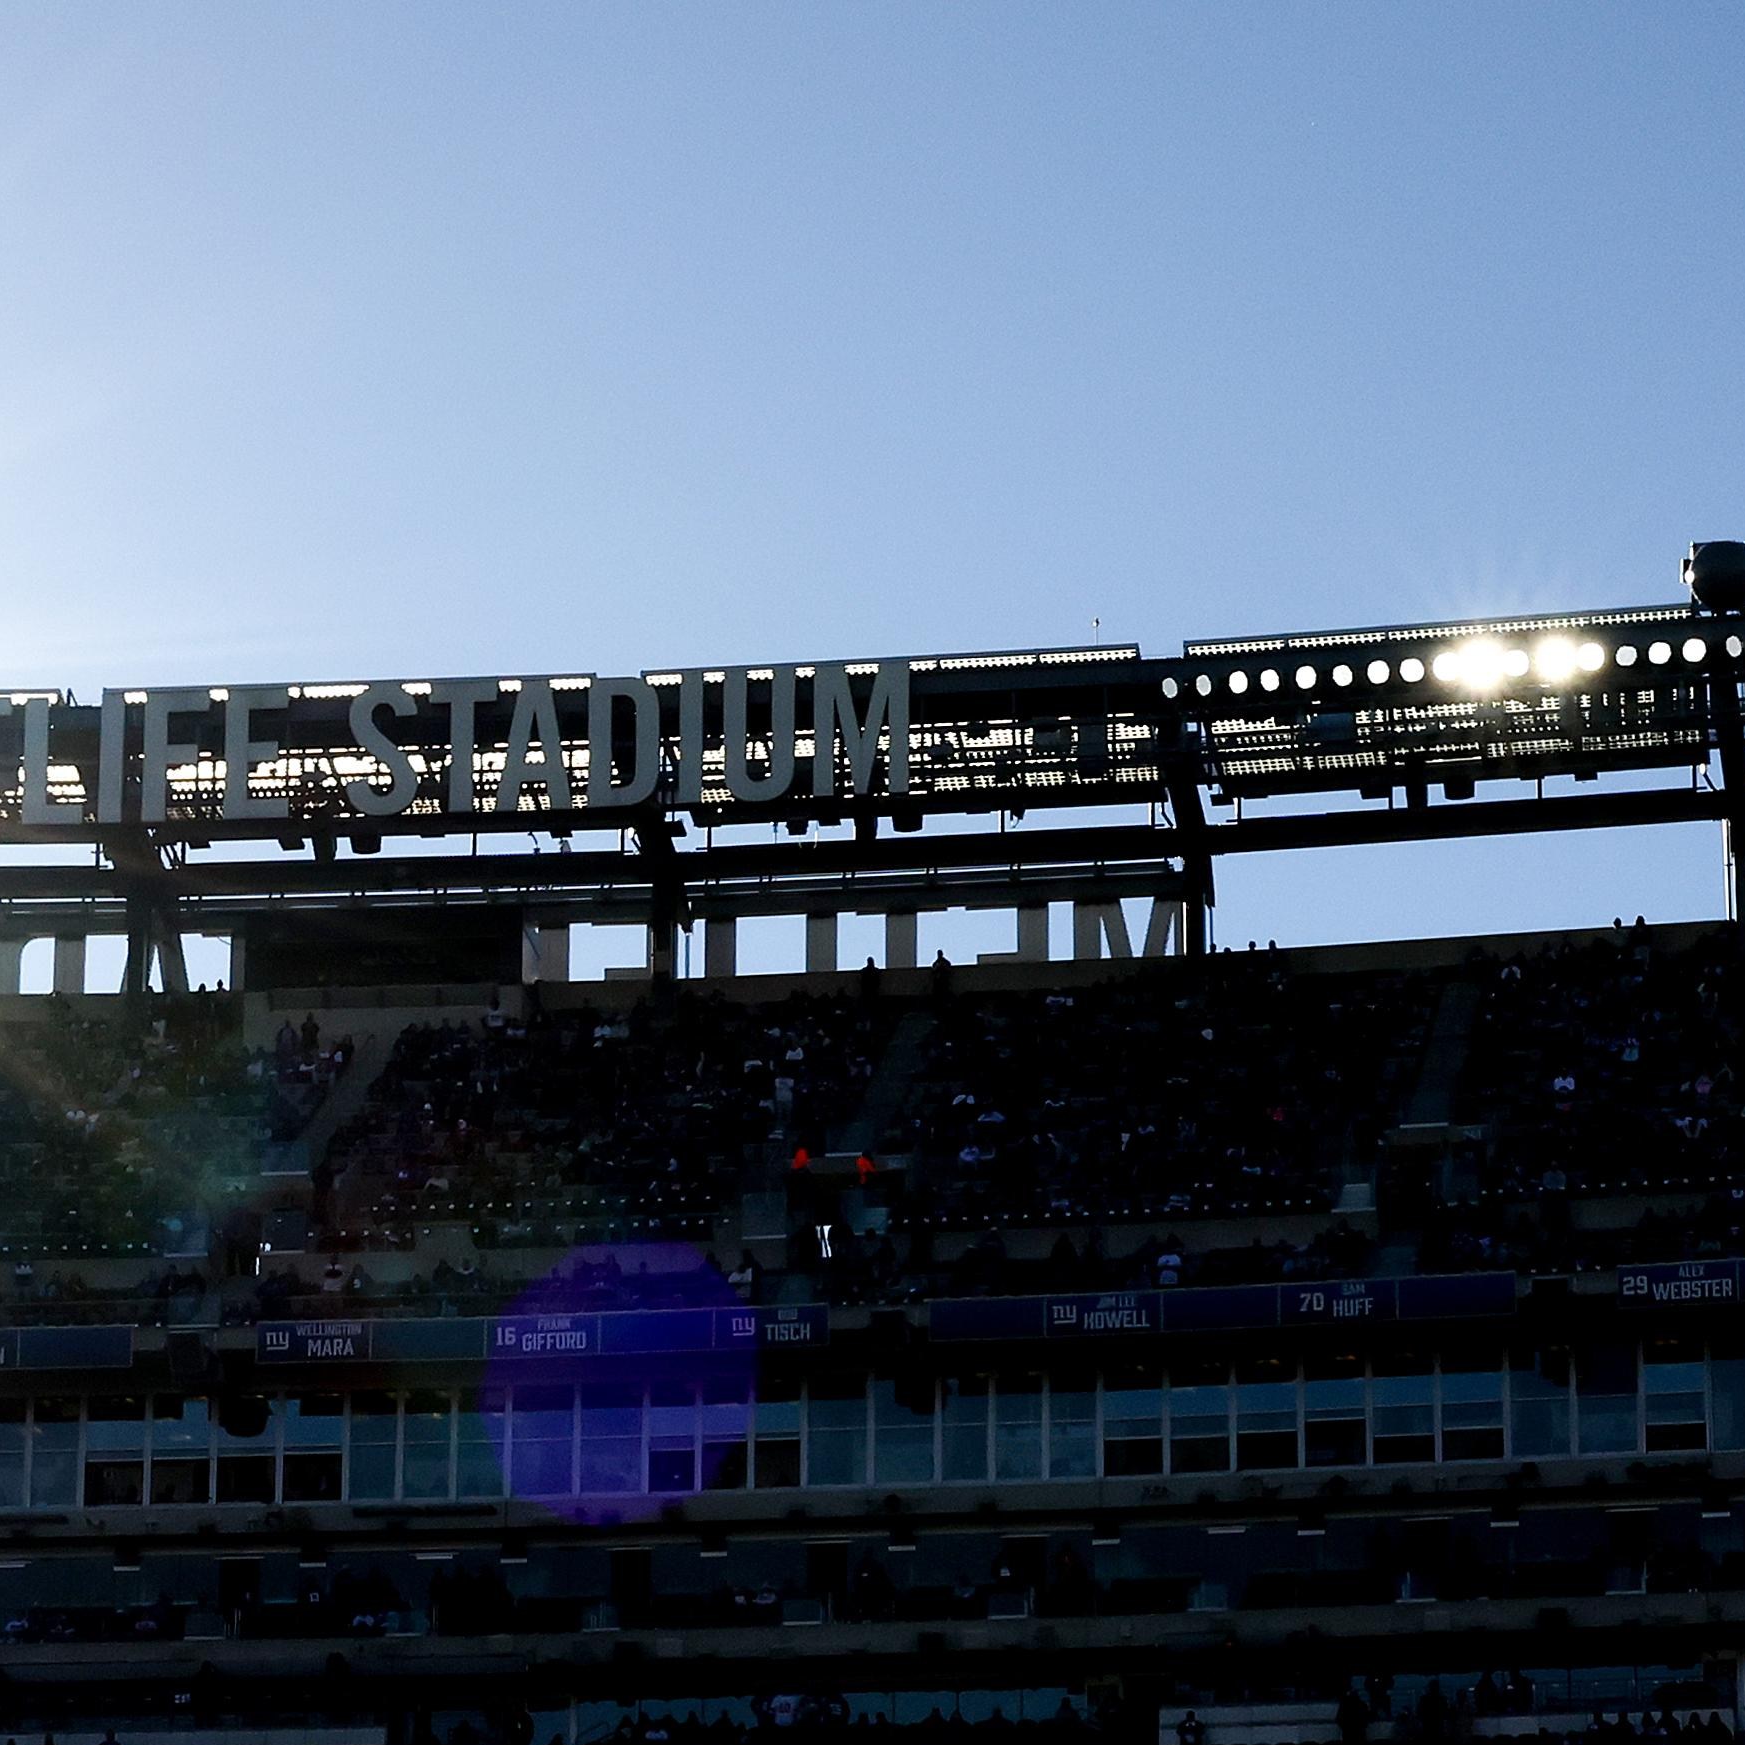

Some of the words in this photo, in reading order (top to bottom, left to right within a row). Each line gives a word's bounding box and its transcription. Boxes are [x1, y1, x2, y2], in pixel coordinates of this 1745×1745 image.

[344, 659, 910, 818] STADIUM
[1622, 1275, 1648, 1296] 29
[1653, 1279, 1733, 1301] WEBSTER
[1299, 1292, 1325, 1313] 70
[1332, 1298, 1375, 1318] HUFF
[1083, 1308, 1150, 1330] HOWELL
[495, 1327, 516, 1347] 16
[521, 1331, 587, 1352] GIFFORD
[765, 1323, 811, 1342] TISCH
[307, 1338, 356, 1357] MARA
